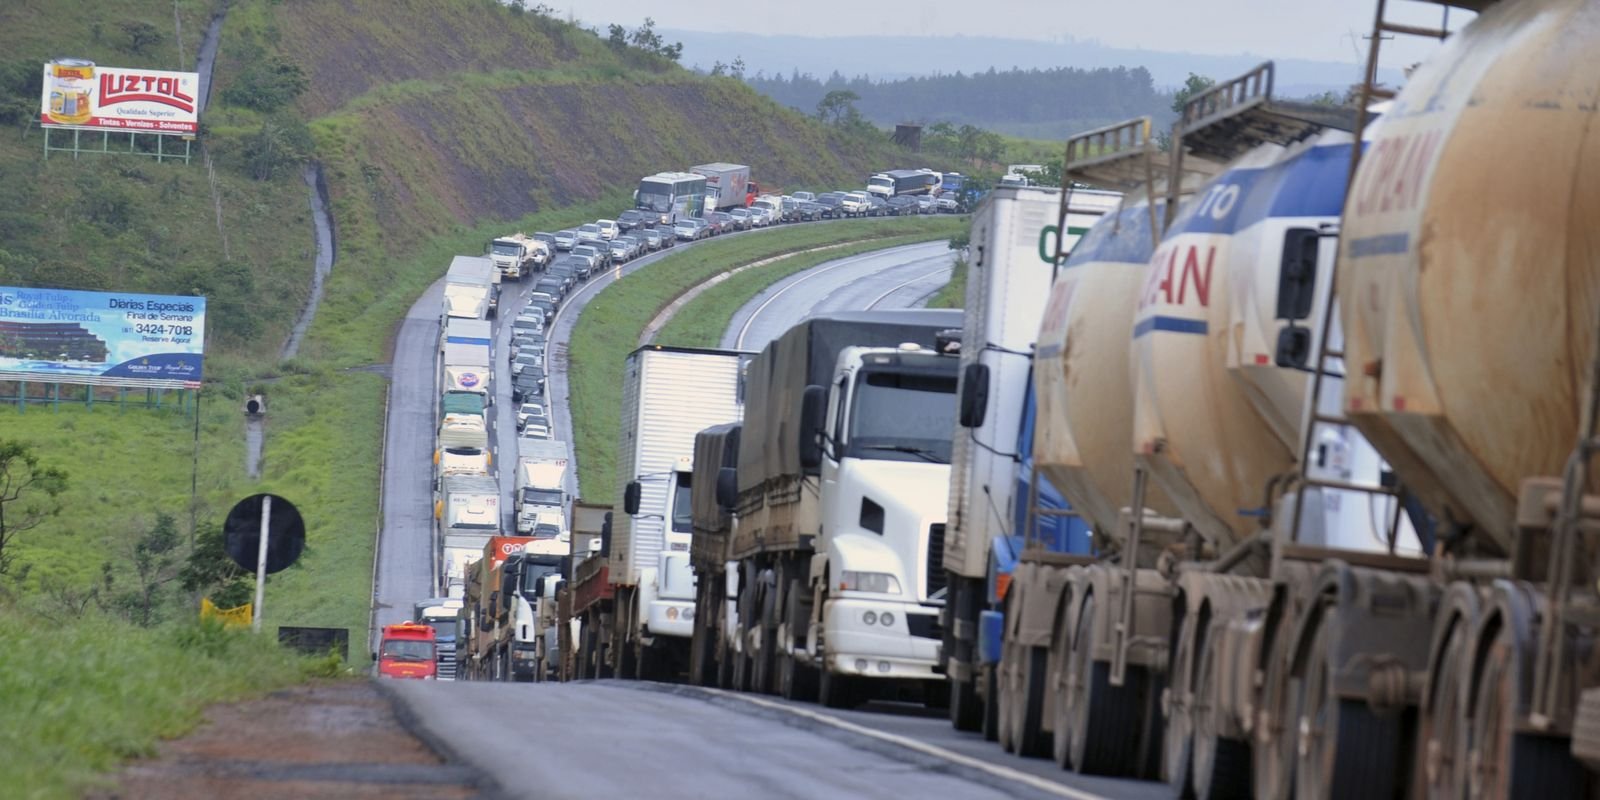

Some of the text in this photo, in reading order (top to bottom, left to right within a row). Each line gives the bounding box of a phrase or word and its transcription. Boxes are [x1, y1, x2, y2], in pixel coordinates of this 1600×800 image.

[98, 73, 194, 112] LUZTOL
[117, 107, 147, 116] Qualidade
[98, 118, 120, 126] Tintas
[126, 119, 154, 128] Vernizes
[159, 121, 193, 130] Solventes
[16, 290, 42, 302] Royal
[18, 300, 53, 309] Golden
[146, 300, 194, 313] Especiais
[48, 310, 101, 322] Alvorada
[127, 311, 193, 322] Final de Semana
[135, 323, 193, 336] 3424-7018
